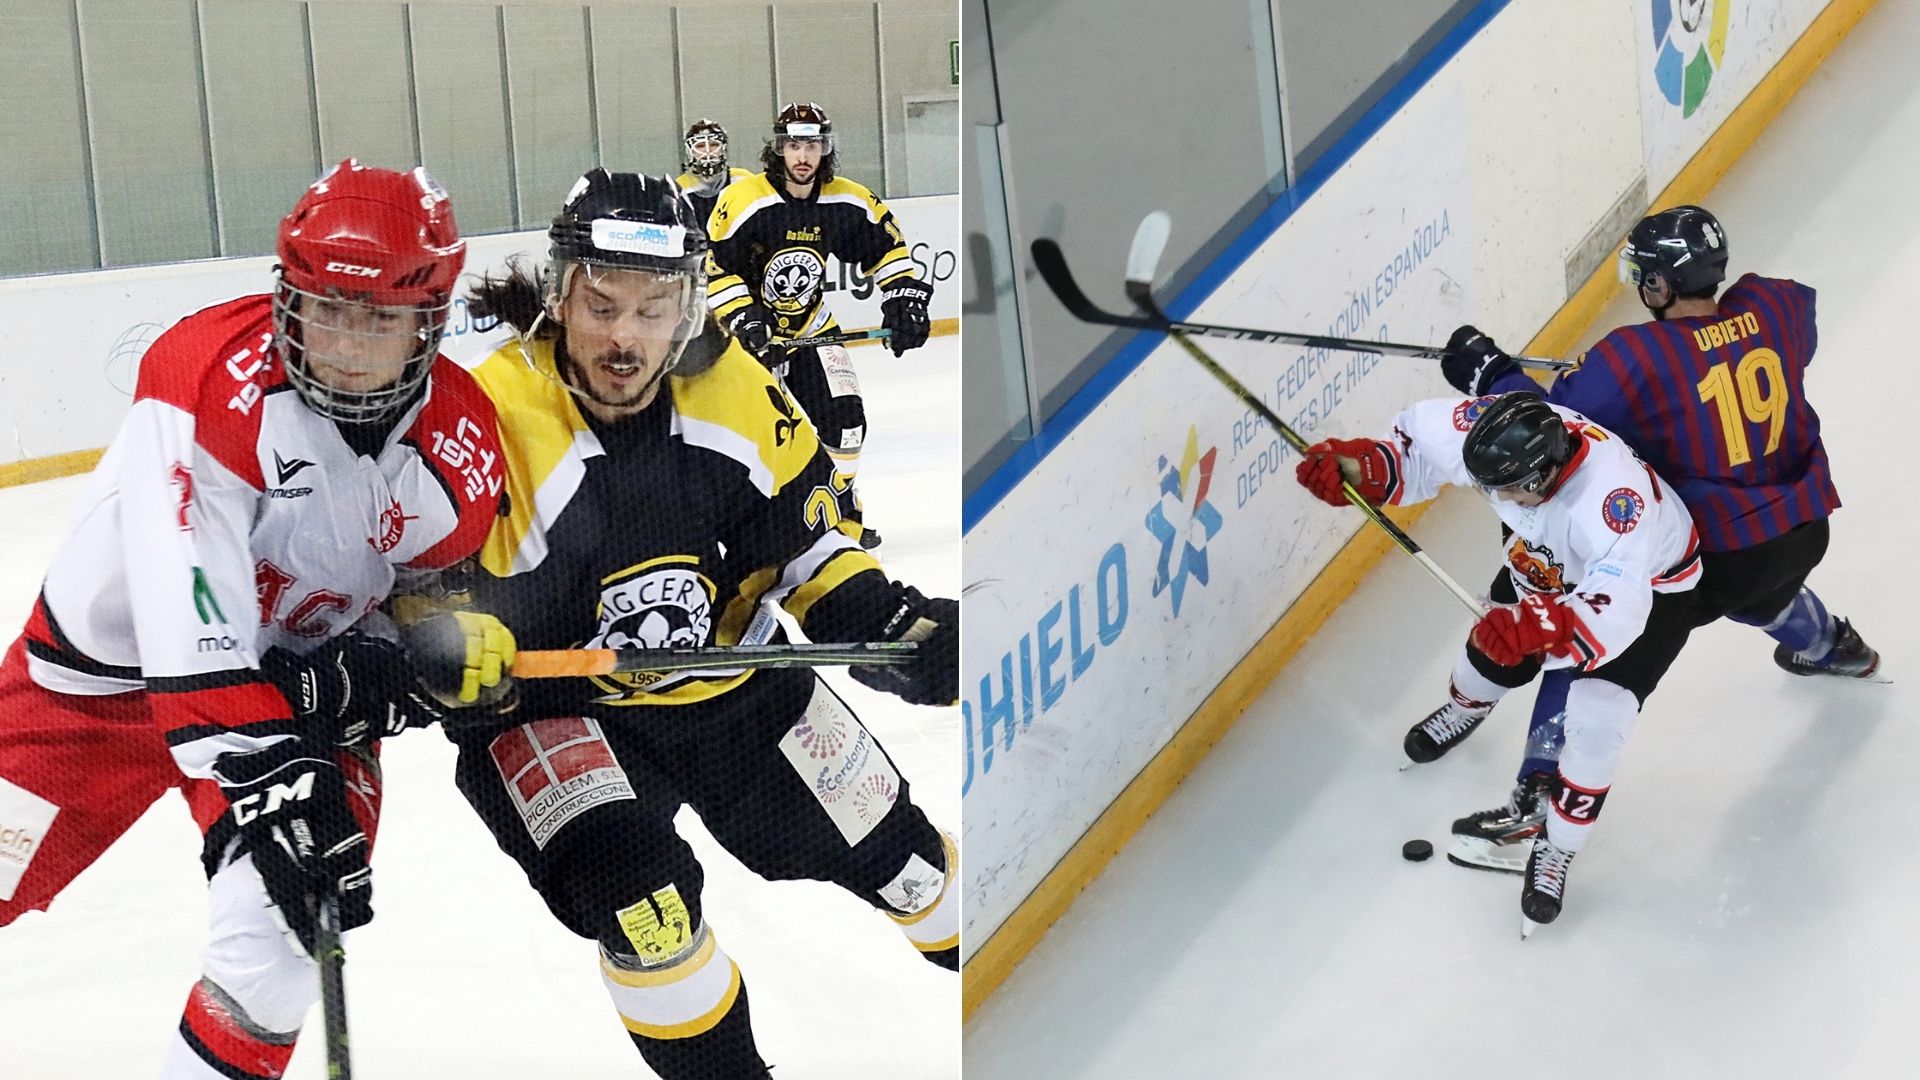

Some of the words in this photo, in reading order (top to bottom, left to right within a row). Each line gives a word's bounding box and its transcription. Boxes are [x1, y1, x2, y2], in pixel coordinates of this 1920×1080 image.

[325, 261, 382, 278] CCM
[1170, 323, 1309, 345] TRUE
[1693, 312, 1760, 351] UBIETO
[1323, 372, 1341, 419] DE
[1346, 324, 1389, 392] HIELO
[1696, 347, 1789, 467] 19
[300, 672, 310, 709] CCM
[601, 770, 624, 780] S.L.
[826, 729, 867, 791] Cerdanya
[535, 784, 630, 841] CONSTRUCCIONS
[1558, 787, 1595, 819] 12
